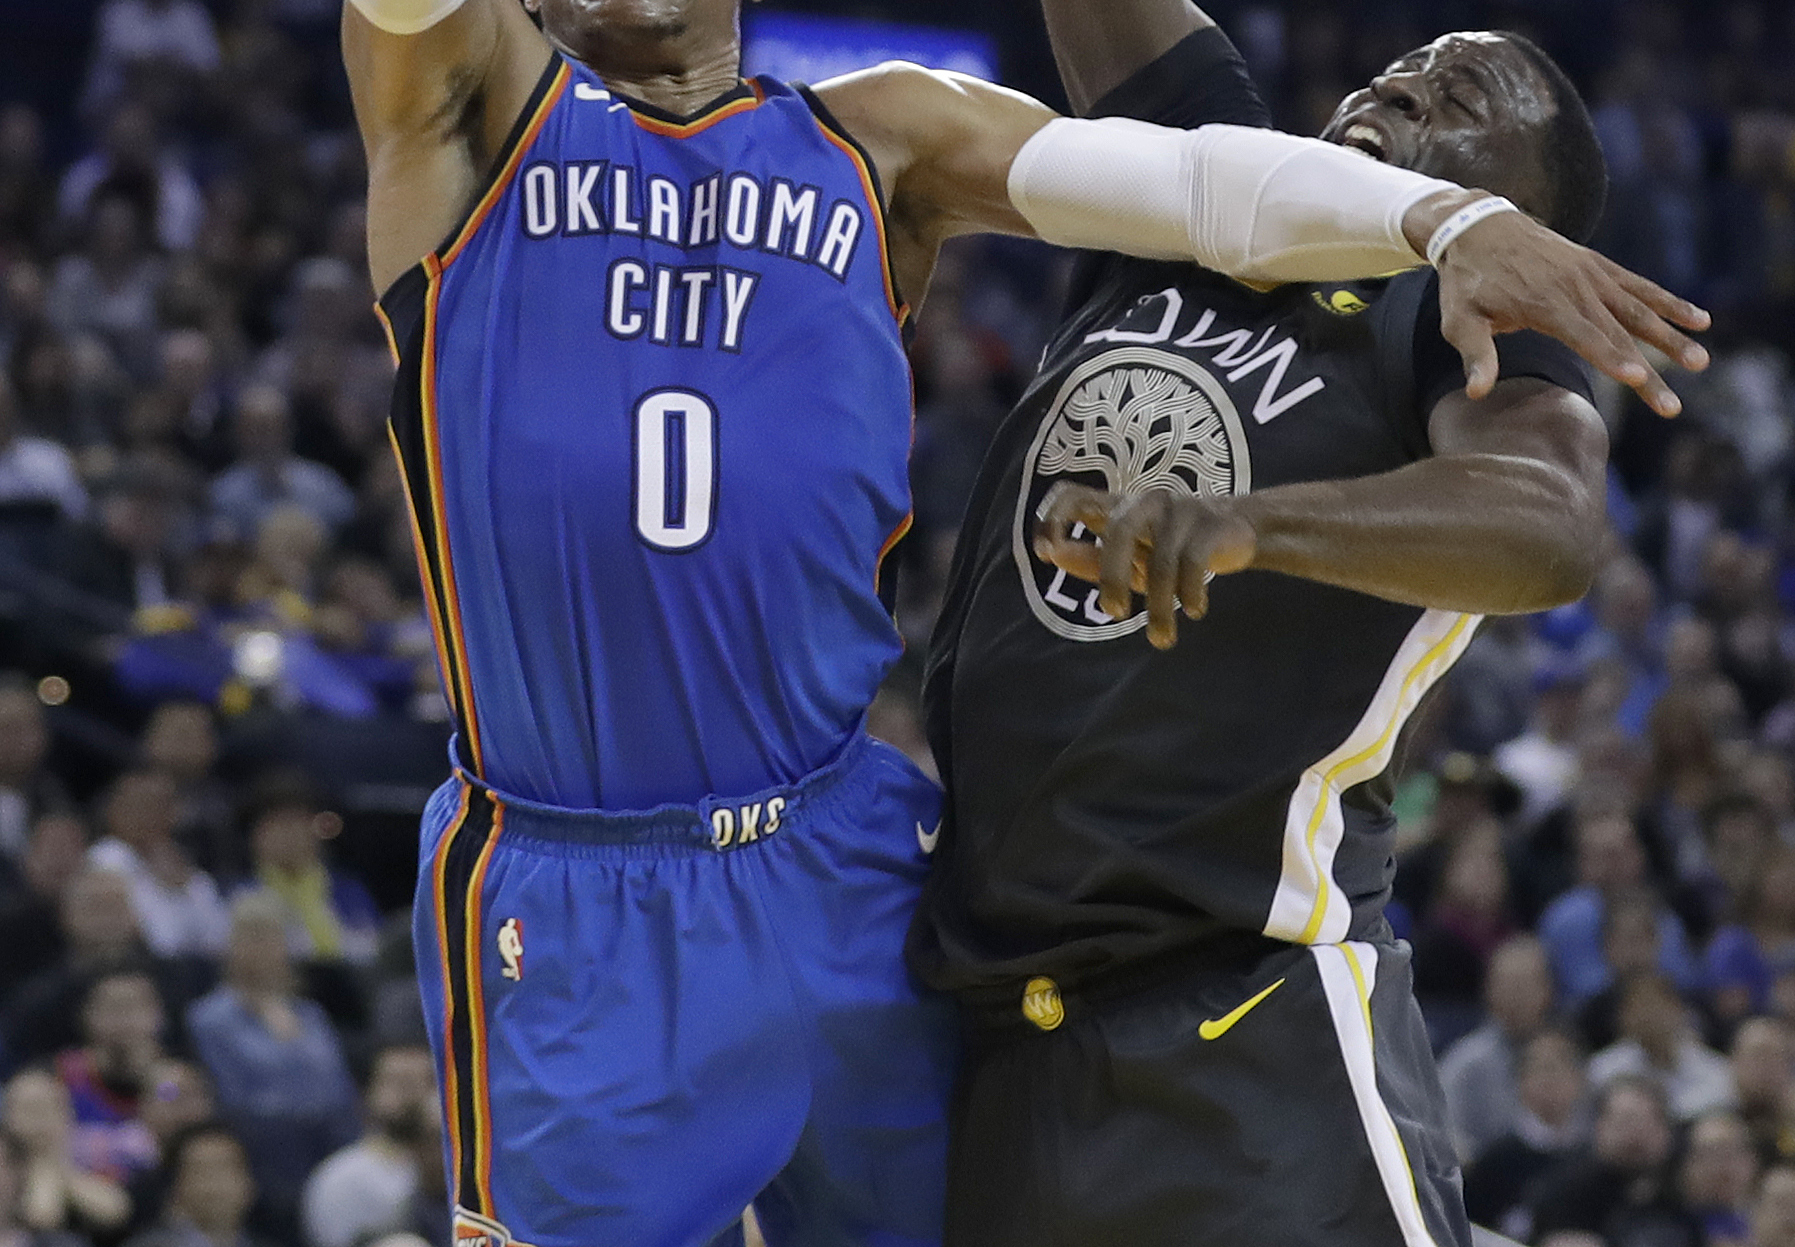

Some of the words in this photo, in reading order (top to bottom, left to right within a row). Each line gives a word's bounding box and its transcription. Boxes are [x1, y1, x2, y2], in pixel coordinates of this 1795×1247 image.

[522, 160, 864, 282] OKLAHOMA
[608, 259, 758, 351] CITY
[632, 388, 718, 553] 0
